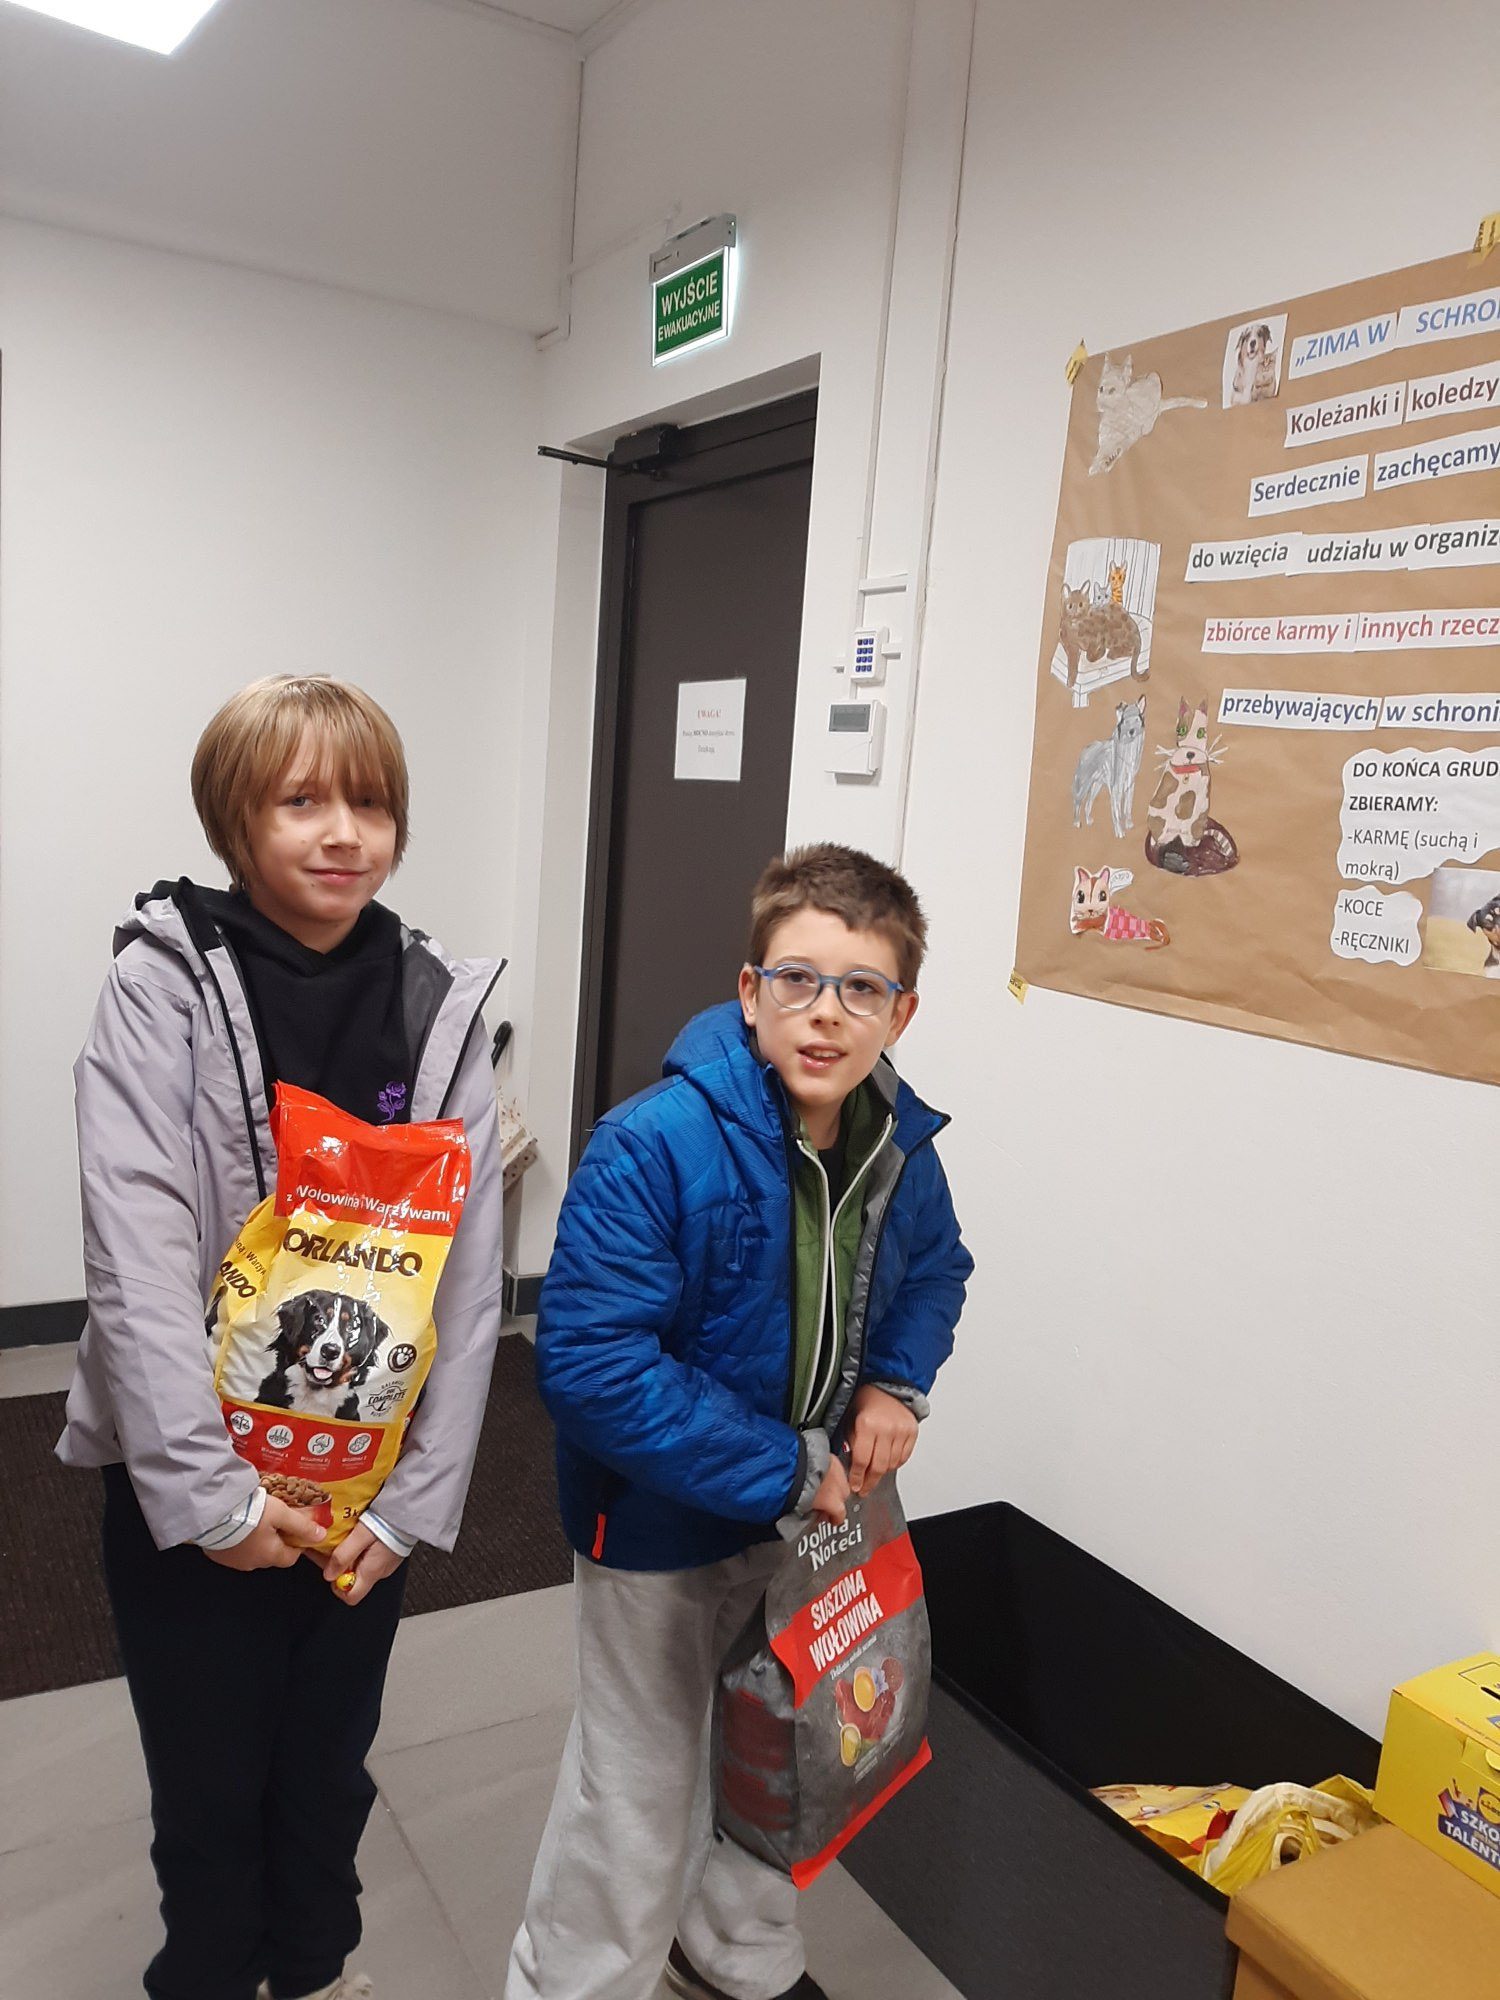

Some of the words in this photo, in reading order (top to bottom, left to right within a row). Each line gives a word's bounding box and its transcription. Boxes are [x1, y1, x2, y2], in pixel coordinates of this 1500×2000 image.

[661, 271, 718, 317] WYJŚCIE
[658, 300, 720, 342] EWAKUACYJNE
[1368, 320, 1390, 345] W
[1416, 298, 1500, 333] SCHRO
[1291, 393, 1387, 435] Koleżanki
[1394, 391, 1400, 412] i
[1412, 376, 1500, 412] koledzy
[1253, 465, 1360, 502] Serdecznie
[1377, 441, 1500, 482] zachęcamy
[1192, 548, 1214, 569] do
[1220, 541, 1289, 568] wzięcia
[1307, 538, 1382, 563] udziału
[1390, 540, 1408, 558] w
[1414, 523, 1500, 554] organiz
[1206, 620, 1271, 642] zbiórce
[1276, 620, 1340, 645] karmy
[1344, 618, 1352, 640] i
[1361, 614, 1433, 642] innych
[1222, 693, 1379, 725] przebywających
[1386, 706, 1406, 722] w
[1411, 698, 1500, 723] schroni
[1353, 762, 1378, 778] DO
[1382, 757, 1441, 778] KOŃCA
[1349, 795, 1439, 812] ZBIERAMY:
[1347, 828, 1410, 850] -KARMĘ
[1414, 829, 1468, 852] (suchą
[1474, 832, 1478, 849] i
[1345, 860, 1399, 881] mokrą)
[1338, 898, 1384, 917] -KOCE
[1334, 931, 1410, 955] -RĘCZNIKI
[286, 1193, 293, 1202] z
[365, 1195, 450, 1222] Warzywami
[282, 1227, 423, 1277] ORLANDO
[343, 1506, 351, 1519] 3
[809, 1523, 863, 1572] Noteci
[810, 1569, 867, 1631] SUSZONA
[808, 1591, 884, 1672] WOŁOWINA
[1444, 1820, 1500, 1866] TALENT
[1460, 1809, 1500, 1844] SZKO
